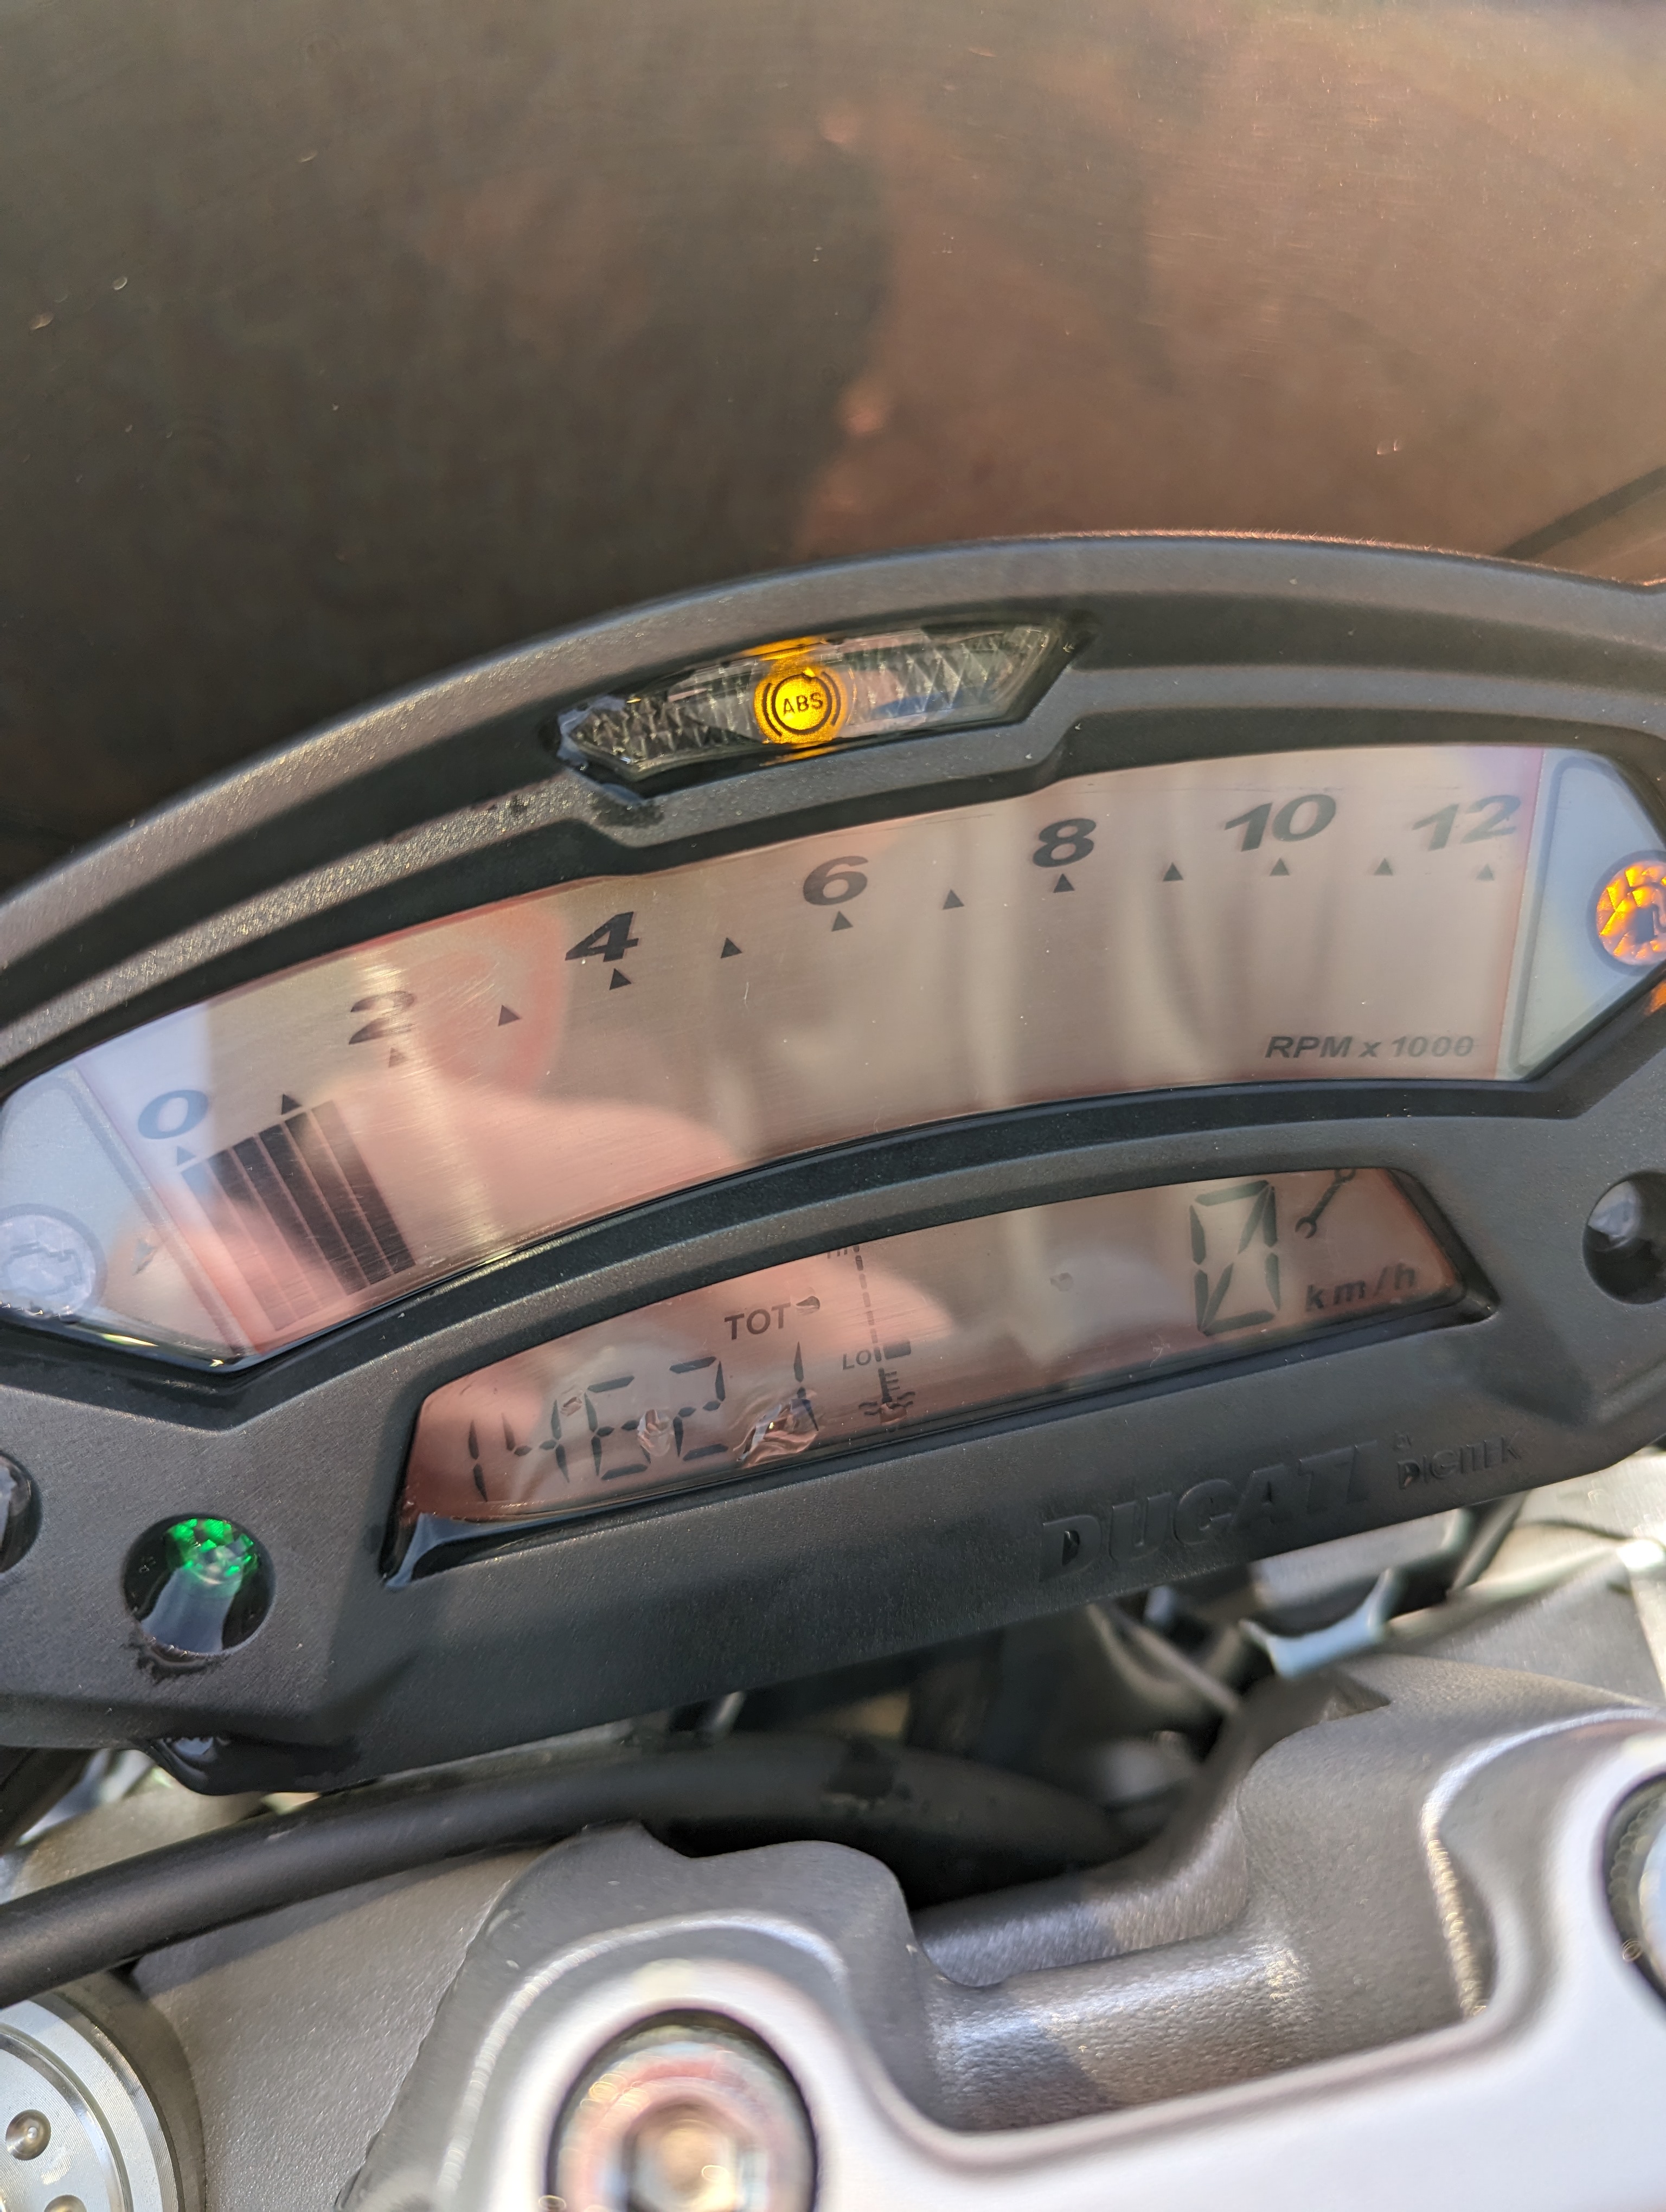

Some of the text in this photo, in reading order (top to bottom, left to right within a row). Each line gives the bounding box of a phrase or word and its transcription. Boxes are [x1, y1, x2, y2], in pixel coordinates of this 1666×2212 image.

[783, 692, 824, 715] ABS
[1032, 818, 1097, 867] 8
[1224, 794, 1336, 852] 10
[1412, 794, 1521, 852] 12
[803, 856, 868, 906] 6
[565, 911, 639, 962] 4
[349, 991, 418, 1045] 2
[1265, 1036, 1474, 1058] RPM x 1000
[138, 1090, 209, 1139] 0
[1306, 1265, 1419, 1311] km/h
[725, 1302, 791, 1340] TOT
[842, 1350, 872, 1370] LO
[469, 1341, 818, 1502] 14621
[1039, 1439, 1377, 1582] DUCATI
